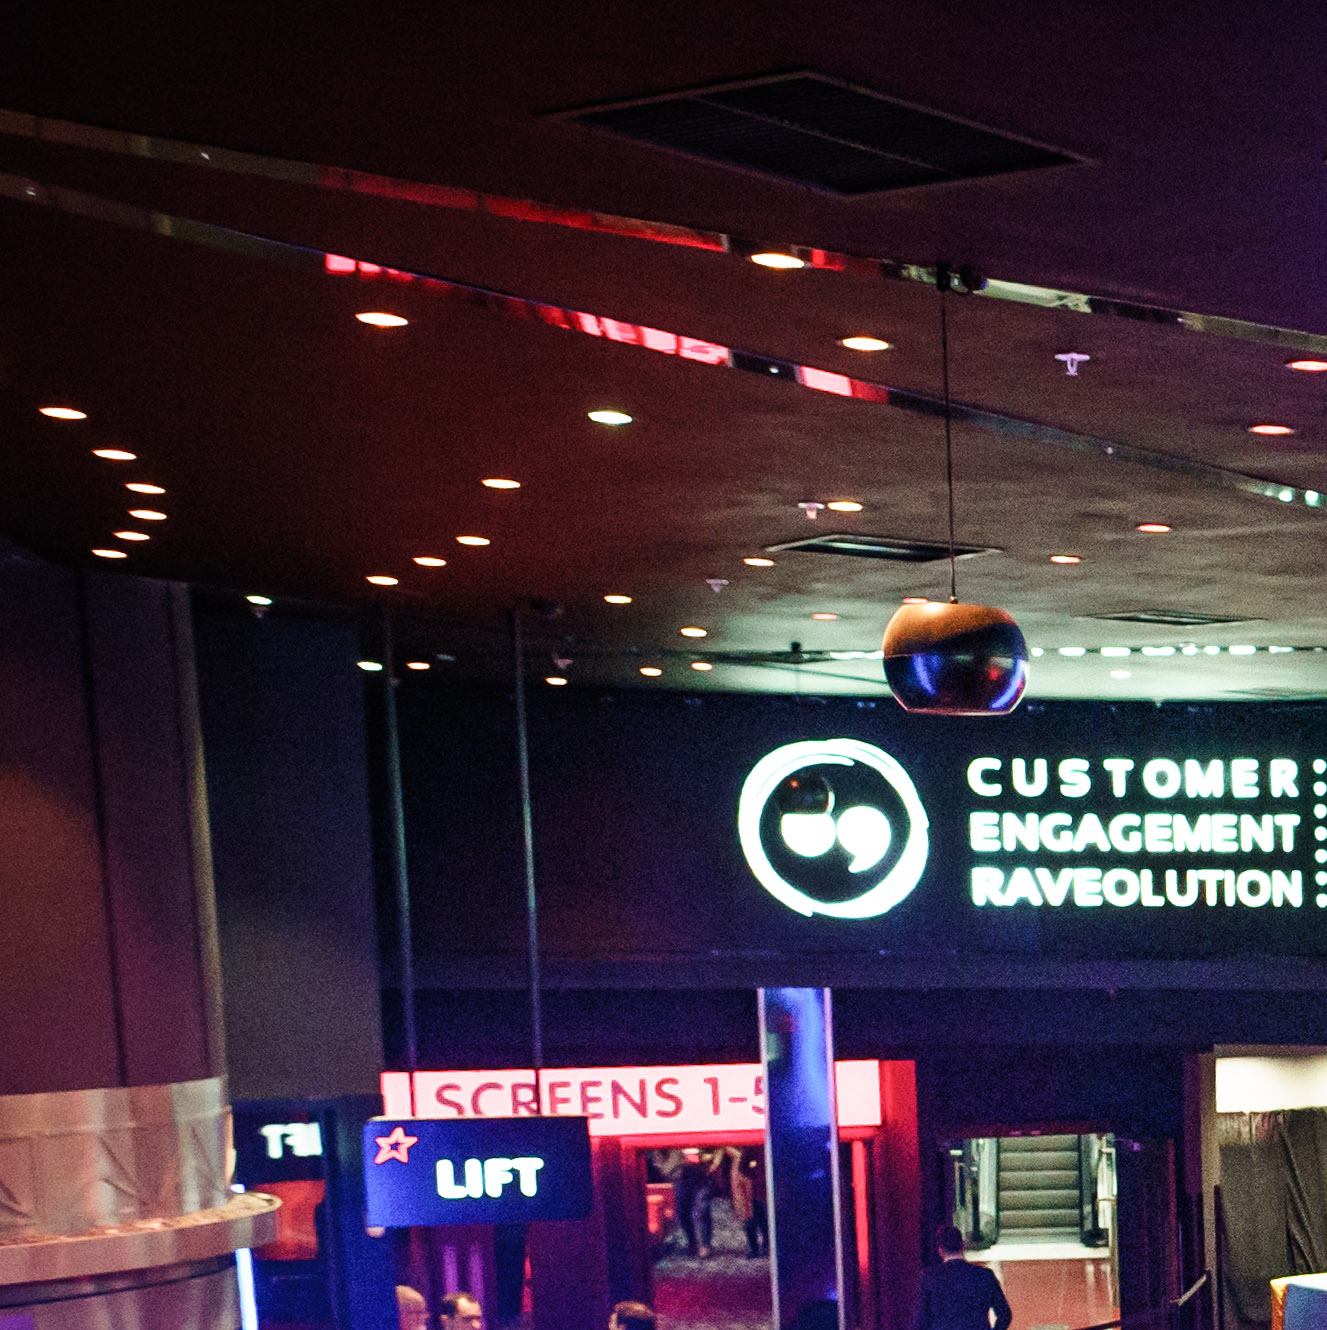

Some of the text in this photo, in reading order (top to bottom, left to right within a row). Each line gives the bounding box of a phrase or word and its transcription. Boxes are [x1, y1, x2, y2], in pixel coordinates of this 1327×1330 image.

[967, 757, 1299, 798] CUSTOMER
[969, 812, 1301, 852] ENGAGEMENT
[971, 867, 1303, 907] RAVEOLUTION
[435, 1077, 684, 1119] SCREENS
[436, 1157, 544, 1199] LIFT
